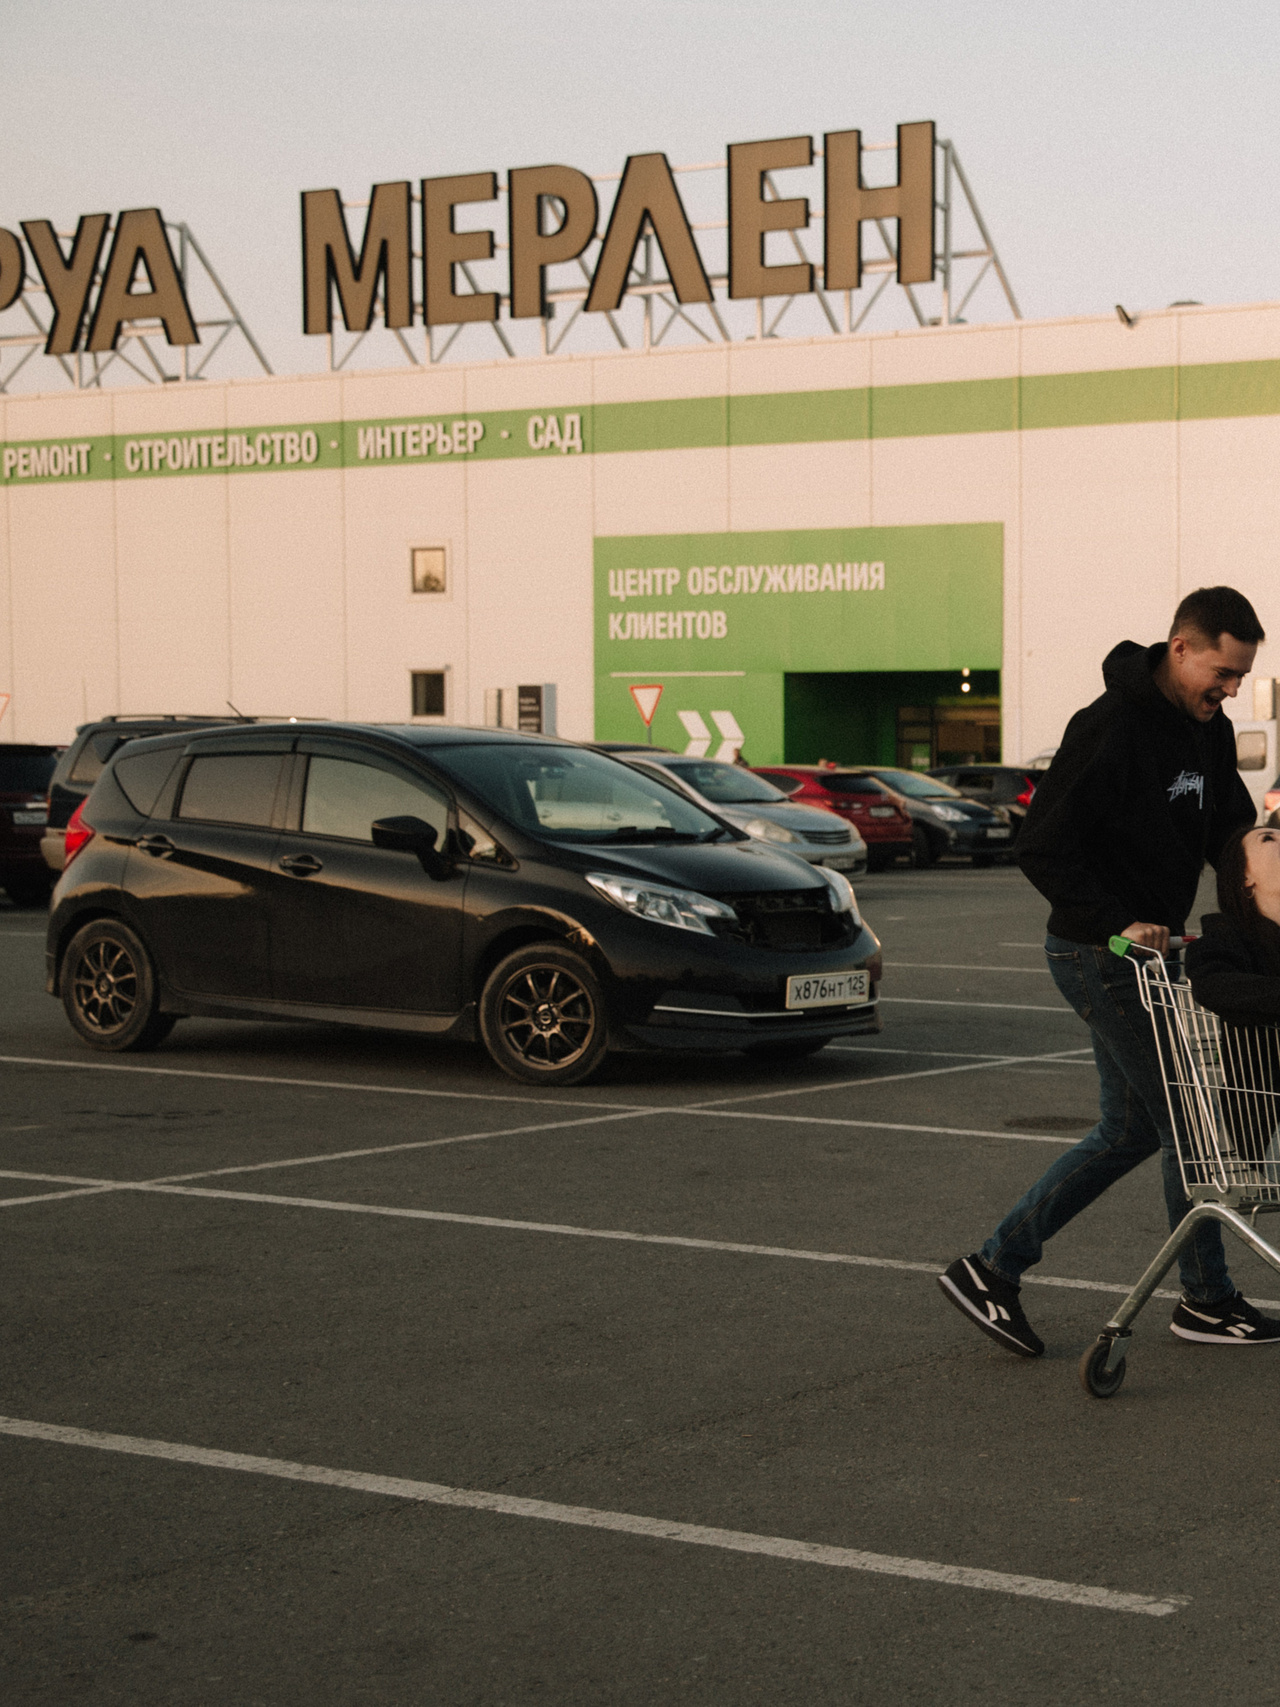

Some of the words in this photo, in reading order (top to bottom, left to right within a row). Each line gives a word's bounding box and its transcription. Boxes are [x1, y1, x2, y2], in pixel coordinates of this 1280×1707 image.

[0, 207, 200, 355] УА
[300, 119, 937, 335] МЕРЛЕН
[4, 443, 92, 479] РЕМОНТ
[124, 429, 318, 473] СТРОИТЕЛЬСТВО
[357, 419, 485, 460] ИНТЕРЬЕР
[527, 412, 583, 454] САД
[608, 567, 681, 602] ЦЕНТР
[686, 561, 886, 596] ОБСЛУЖИВАНИЯ
[608, 610, 729, 641] КЛИЕНТОВ
